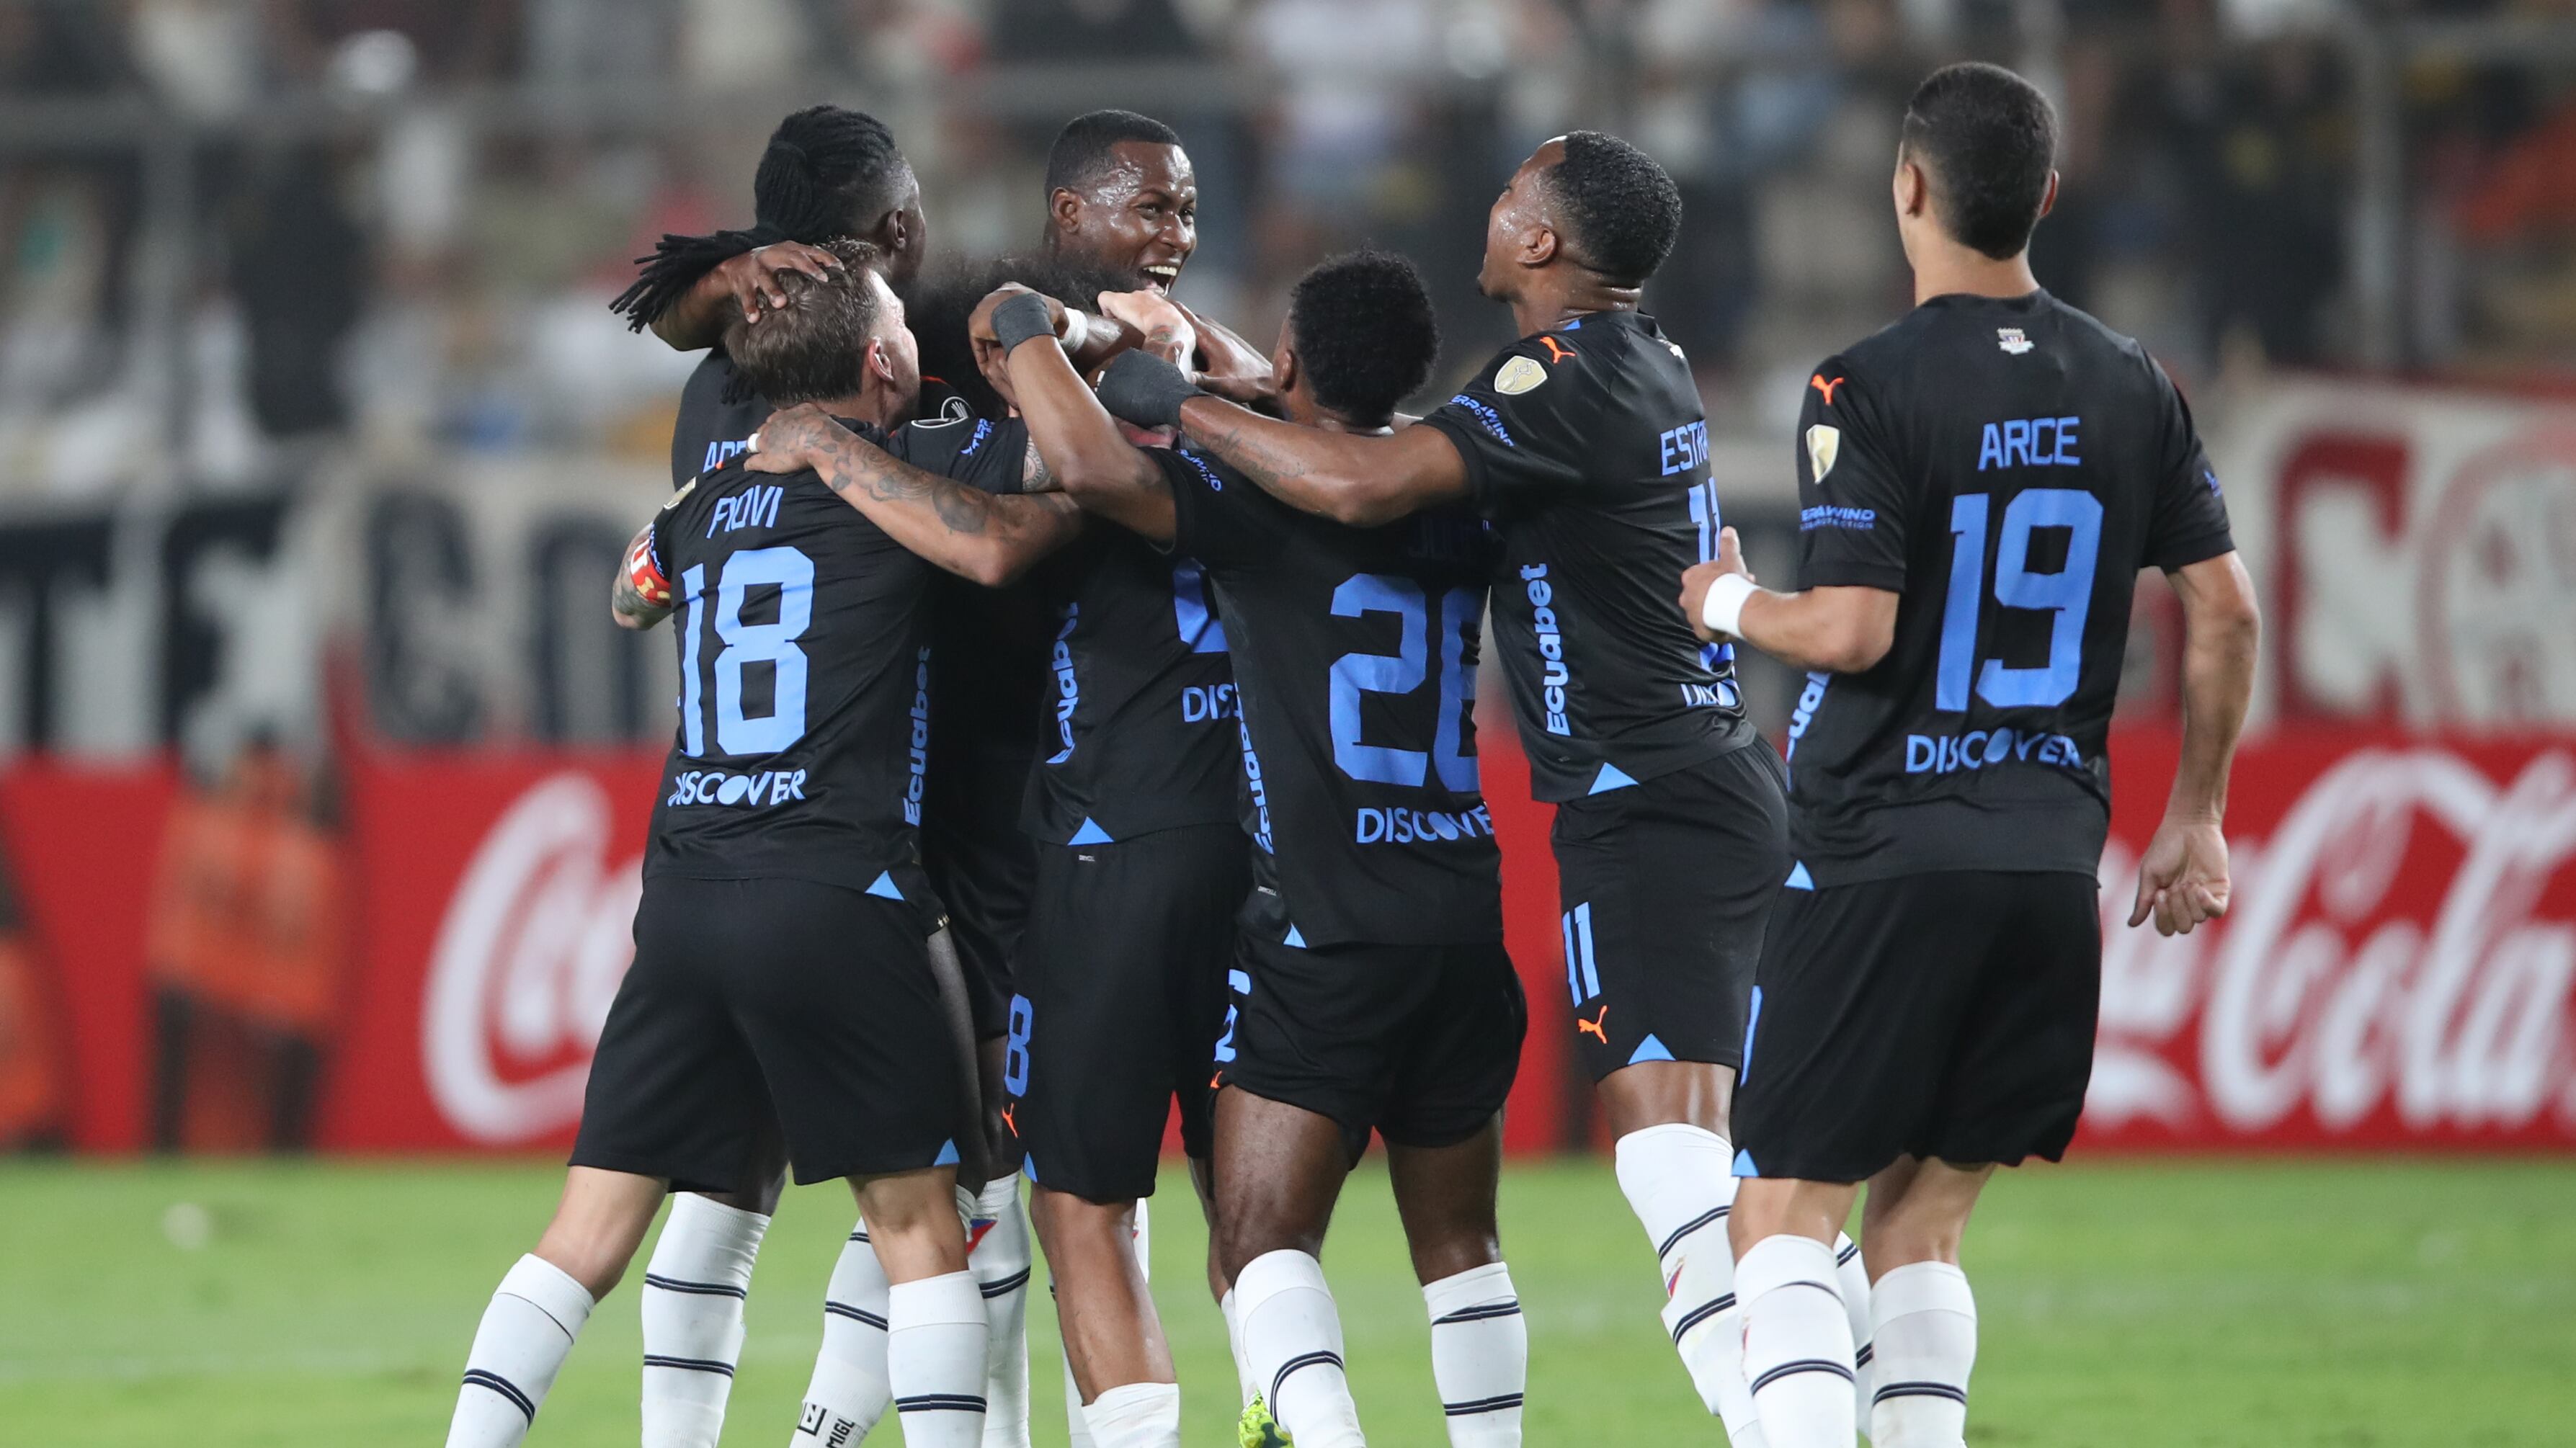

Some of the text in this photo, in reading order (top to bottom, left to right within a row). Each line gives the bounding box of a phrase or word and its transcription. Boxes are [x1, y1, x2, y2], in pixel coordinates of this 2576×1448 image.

[1660, 419, 1708, 476] ESTR
[1978, 416, 2081, 472] ARCE
[1935, 488, 2103, 712] 19
[680, 546, 816, 757] 18
[1519, 563, 1572, 736] Ecuabet
[1906, 726, 2083, 774] DISCOVER
[1356, 805, 1494, 844] DISCOVE
[1561, 902, 1601, 1008] 11
[1004, 993, 1033, 1097] 8
[826, 1418, 855, 1448] MIGL
